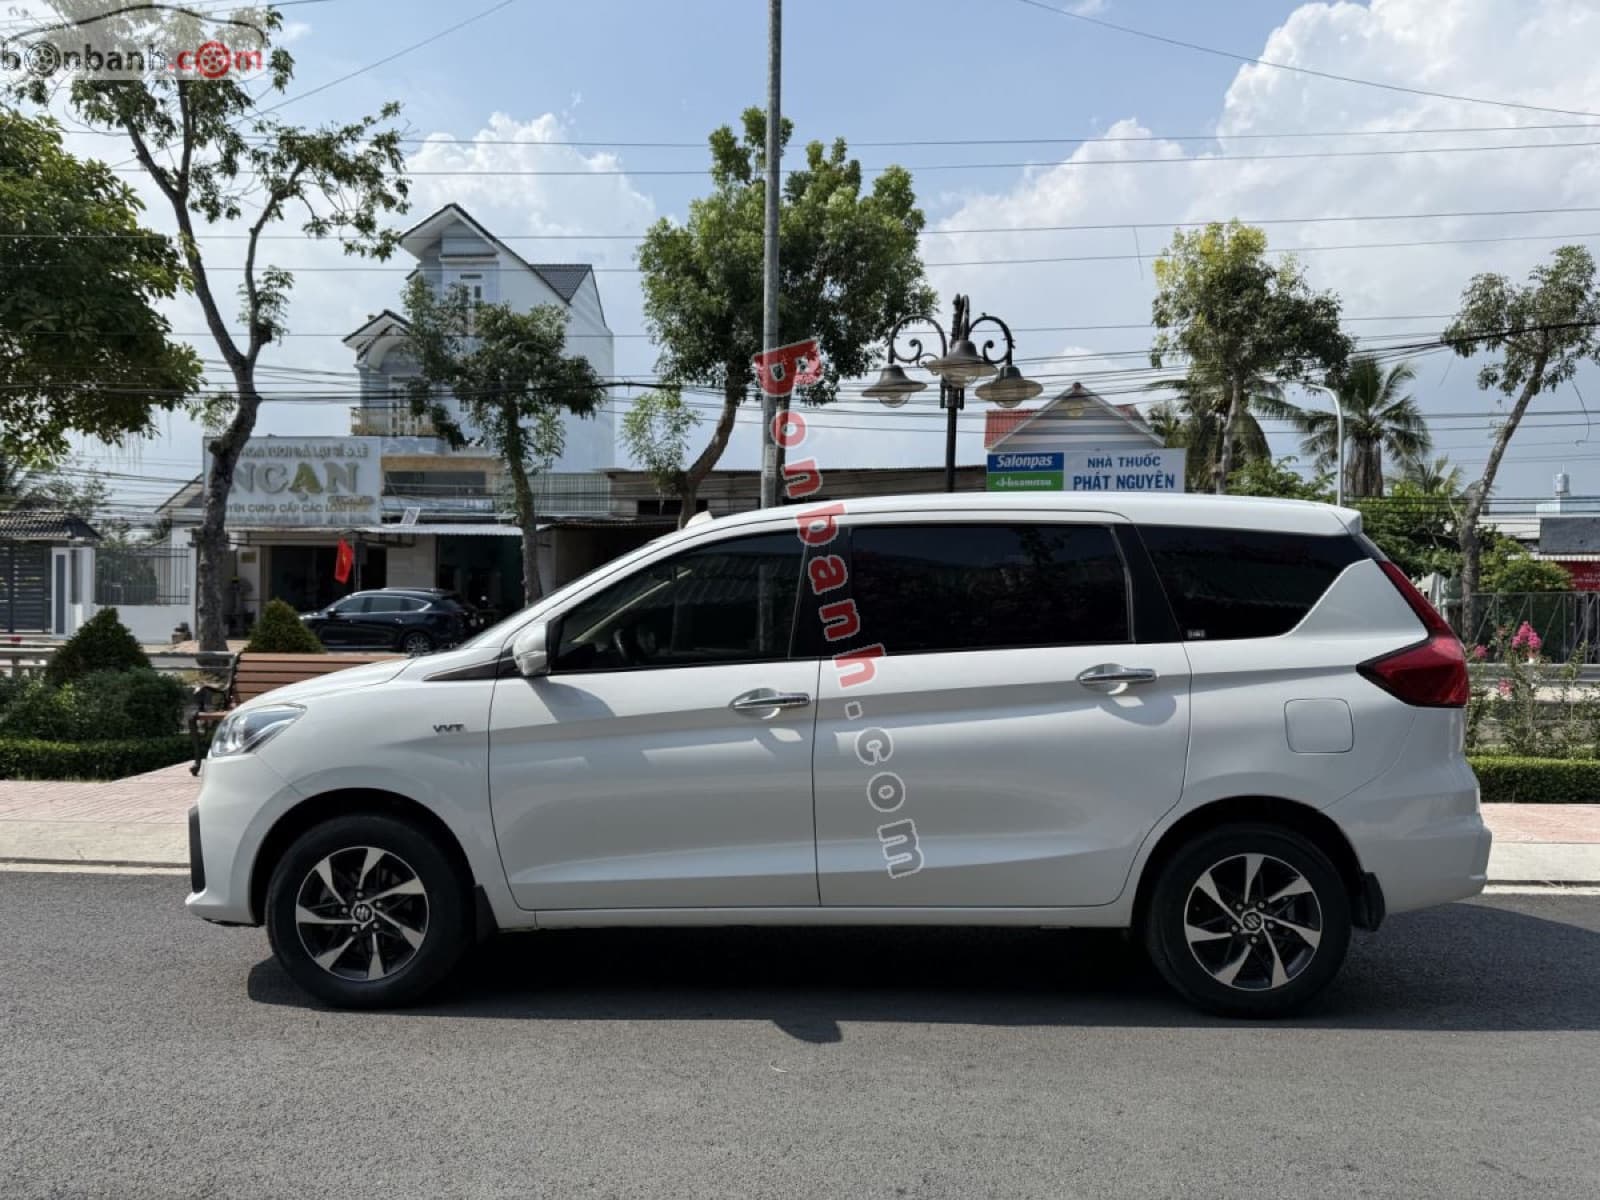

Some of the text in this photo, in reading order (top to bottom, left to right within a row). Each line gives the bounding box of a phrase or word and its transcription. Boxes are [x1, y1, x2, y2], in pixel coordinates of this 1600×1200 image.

[997, 455, 1053, 469] Salonpas
[1087, 453, 1161, 468] NHÀ THUỐC
[1073, 472, 1111, 490] PHÁT
